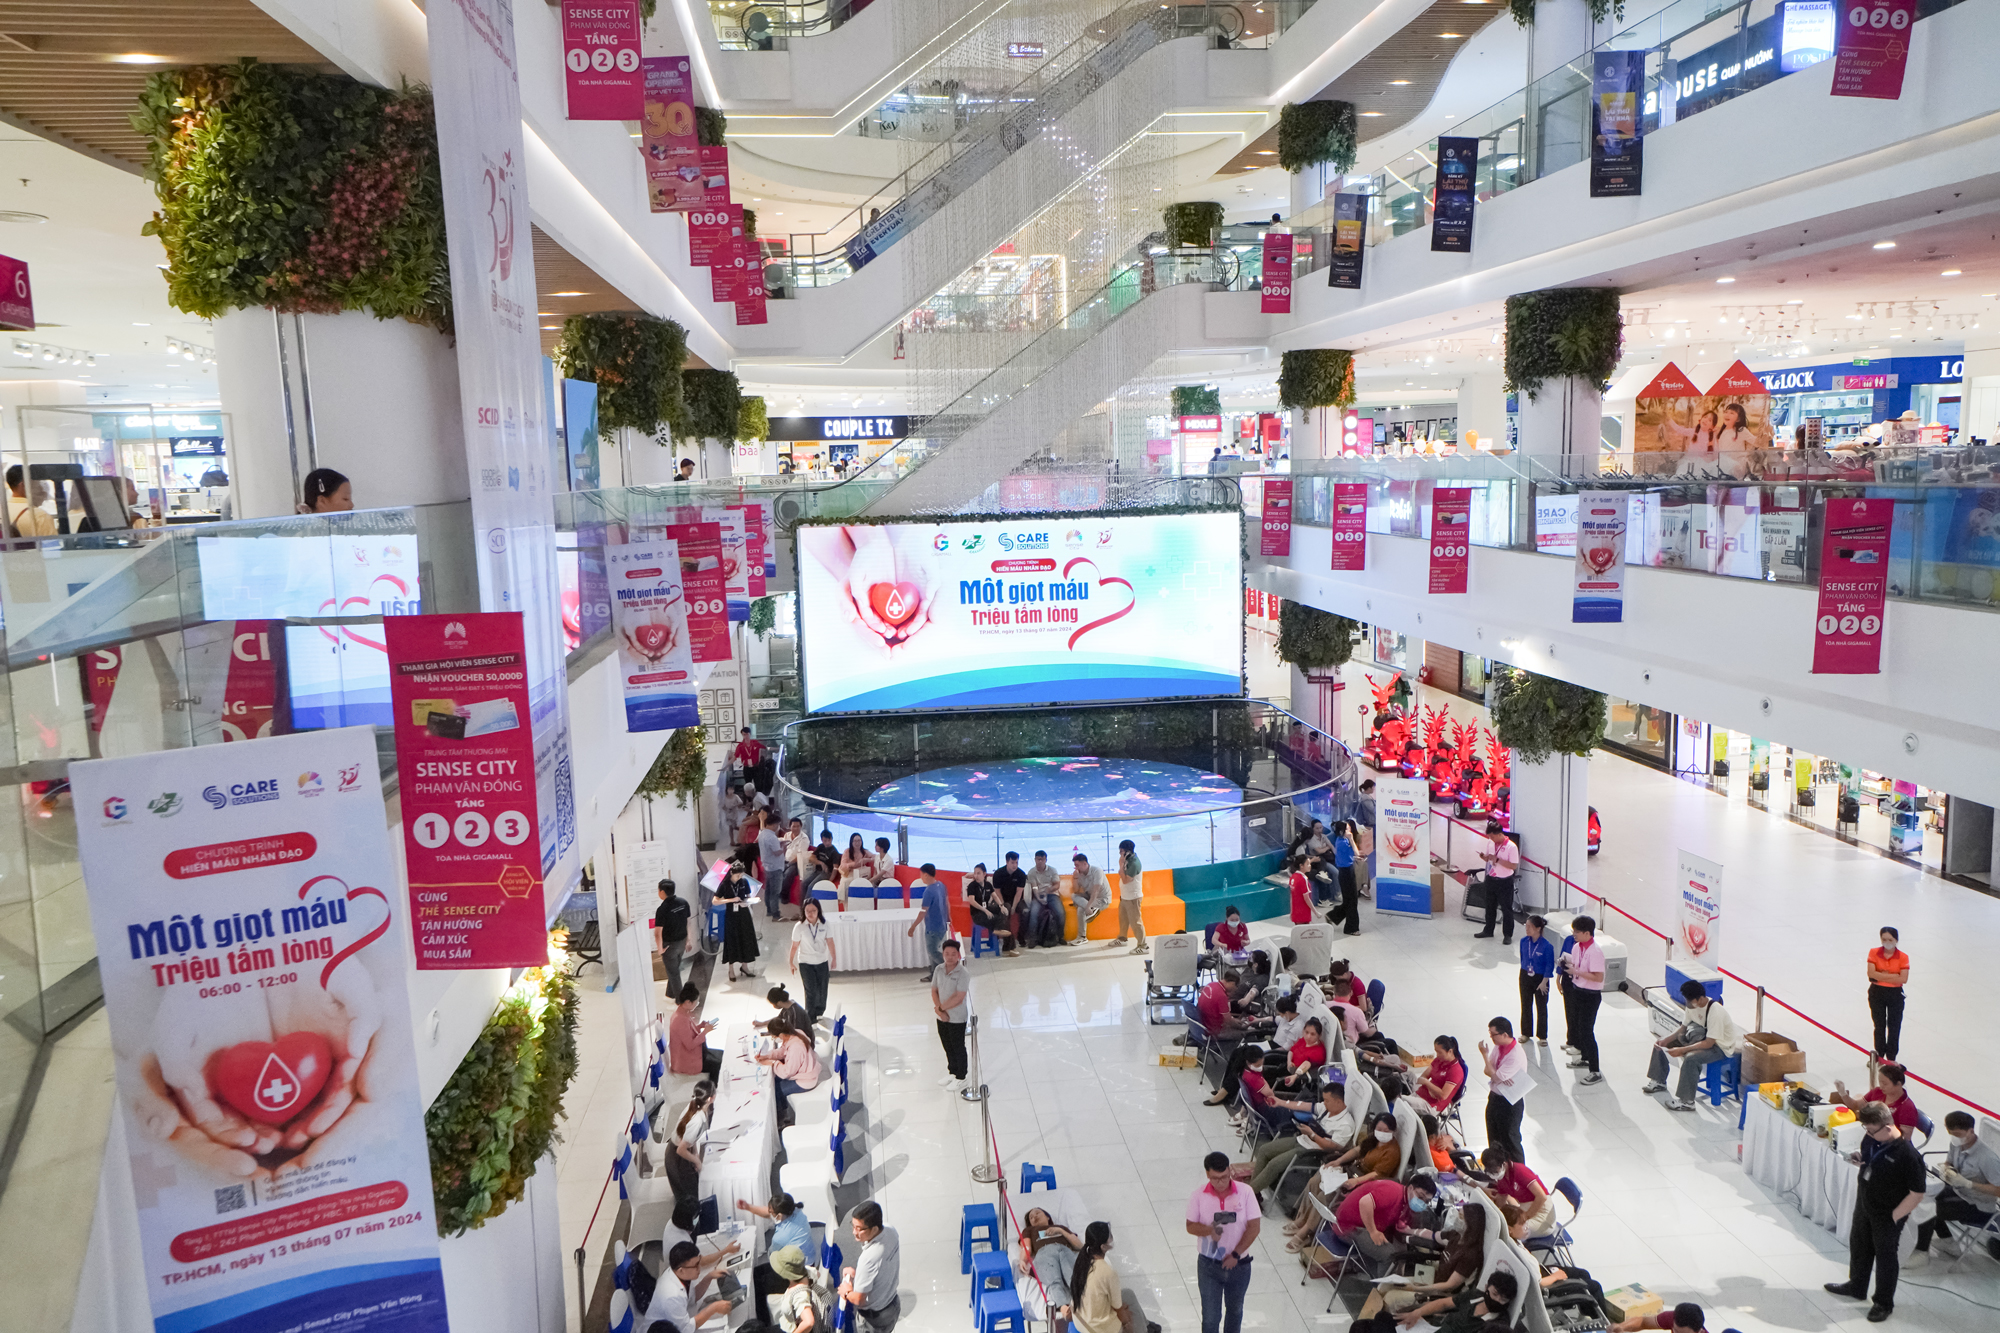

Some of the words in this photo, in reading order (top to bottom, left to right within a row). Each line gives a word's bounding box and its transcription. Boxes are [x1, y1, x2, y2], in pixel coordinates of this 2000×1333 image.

[569, 9, 604, 19] SENSE
[606, 9, 630, 18] CITY
[1854, 11, 1864, 22] 1
[1874, 12, 1884, 24] 2
[1896, 14, 1904, 25] 3
[573, 53, 582, 66] 1
[598, 53, 608, 67] 2
[623, 53, 632, 67] 3
[647, 70, 679, 80] GRAND
[645, 78, 684, 88] OPENING
[865, 213, 896, 238] GREATER
[870, 217, 906, 246] EVERYDAY
[14, 270, 27, 298] 6
[478, 406, 500, 426] SCID
[824, 420, 874, 438] COUPLE
[876, 418, 894, 436] TX
[1017, 532, 1049, 542] CARE
[1010, 564, 1023, 572] MÁU
[1024, 564, 1040, 572] NHÂN
[617, 588, 636, 600] Một
[637, 588, 652, 598] giọt
[654, 586, 670, 596] máu
[960, 578, 1004, 606] Một
[1008, 580, 1044, 605] giọt
[1049, 578, 1089, 602] máu
[1826, 582, 1856, 591] SENSE
[1858, 582, 1879, 591] CITY
[698, 604, 704, 612] 2
[714, 602, 720, 610] 3
[971, 606, 1010, 627] Triệu
[1014, 604, 1042, 624] tấm
[1047, 606, 1079, 624] lòng
[1824, 618, 1830, 630] 1
[1844, 618, 1854, 630] 2
[1866, 618, 1874, 630] 3
[1024, 628, 1038, 636] tháng
[402, 663, 424, 672] THAM
[425, 662, 438, 670] GIA
[440, 660, 454, 670] HỘI
[456, 658, 472, 667] VIÊN
[474, 657, 496, 666] SENSE
[498, 656, 515, 664] CITY
[414, 674, 440, 684] NHẬN
[440, 673, 484, 682] VOUCHER
[416, 762, 473, 778] SENSE
[476, 760, 518, 776] CITY
[230, 778, 279, 796] CARE
[416, 782, 453, 797] PHẠM
[455, 780, 481, 793] VĂN
[232, 792, 280, 806] SOLUTIONS
[1384, 808, 1398, 817] Một
[1409, 811, 1421, 819] máu
[424, 821, 436, 841] 1
[464, 819, 480, 840] 2
[504, 818, 520, 838] 3
[196, 844, 246, 860] CHƯƠNG
[250, 838, 284, 851] TRÌNH
[212, 856, 240, 870] MÁU
[242, 852, 276, 866] NHÂN
[278, 848, 304, 861] ĐẠO
[436, 854, 452, 862] TÒA
[418, 891, 448, 903] CÙNG
[444, 906, 476, 916] SENSE
[478, 905, 502, 915] CITY
[127, 914, 207, 960] Một
[214, 908, 276, 948] giọt
[282, 896, 348, 934] máu
[420, 921, 442, 934] TẬN
[447, 932, 468, 944] XÚC
[423, 950, 446, 959] MUA
[151, 956, 221, 988] Triệu
[227, 944, 276, 976] tấm
[282, 936, 334, 965] lòng
[198, 982, 242, 999] 06:00
[257, 972, 298, 989] 12:00
[162, 1263, 226, 1286] TP.HCM,
[230, 1250, 265, 1270] ngày
[270, 1244, 288, 1258] 13
[290, 1234, 331, 1252] tháng
[334, 1228, 352, 1240] 07
[356, 1222, 385, 1236] năm
[388, 1210, 422, 1228] 2024
[333, 1312, 352, 1322] City
